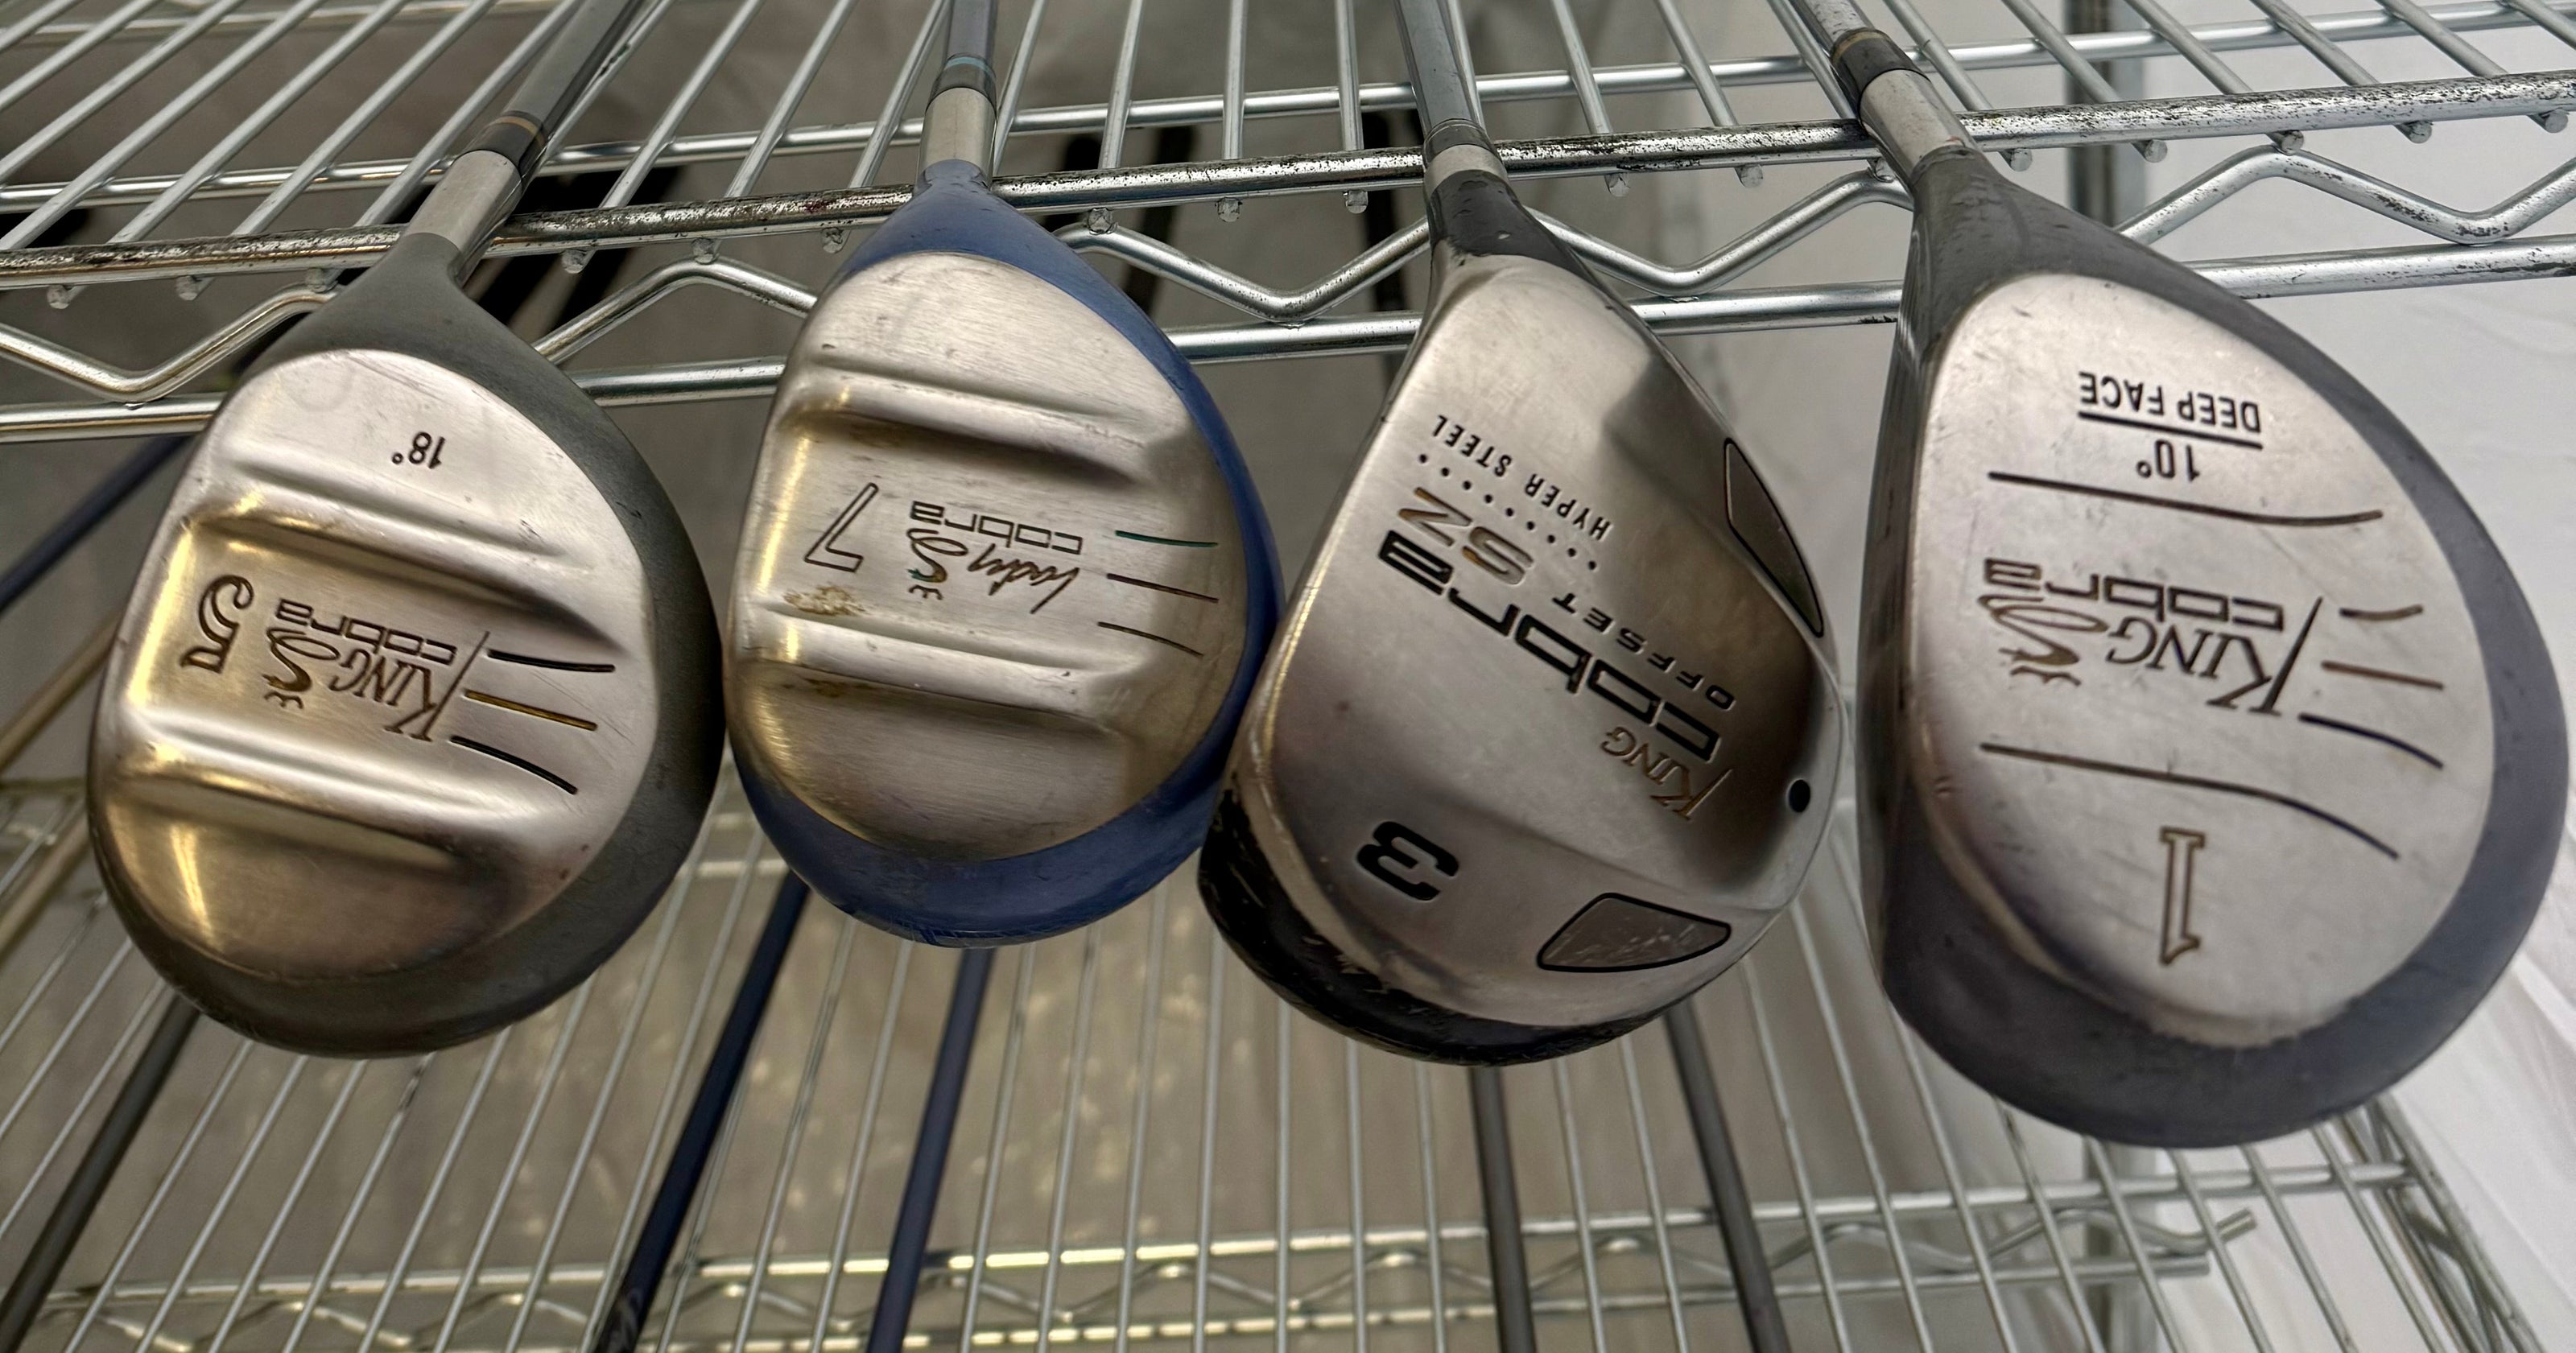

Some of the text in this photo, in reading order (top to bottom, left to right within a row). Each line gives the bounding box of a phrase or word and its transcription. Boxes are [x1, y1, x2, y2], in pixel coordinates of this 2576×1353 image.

[2078, 371, 2261, 434] DEEP FACE
[1430, 415, 1611, 541] HYPER STEEL
[803, 482, 879, 573] 7
[911, 501, 1083, 555] cobra
[179, 574, 254, 674] 5
[275, 598, 457, 666] cobra
[1397, 486, 1736, 712] OFFSET SZ
[1984, 558, 2286, 633] cobra
[328, 630, 489, 743] KING
[1377, 530, 1723, 762] cobra
[2106, 596, 2324, 719] KING
[1599, 725, 1733, 821] KING
[1356, 820, 1459, 901] 3
[2159, 826, 2207, 966] 1
